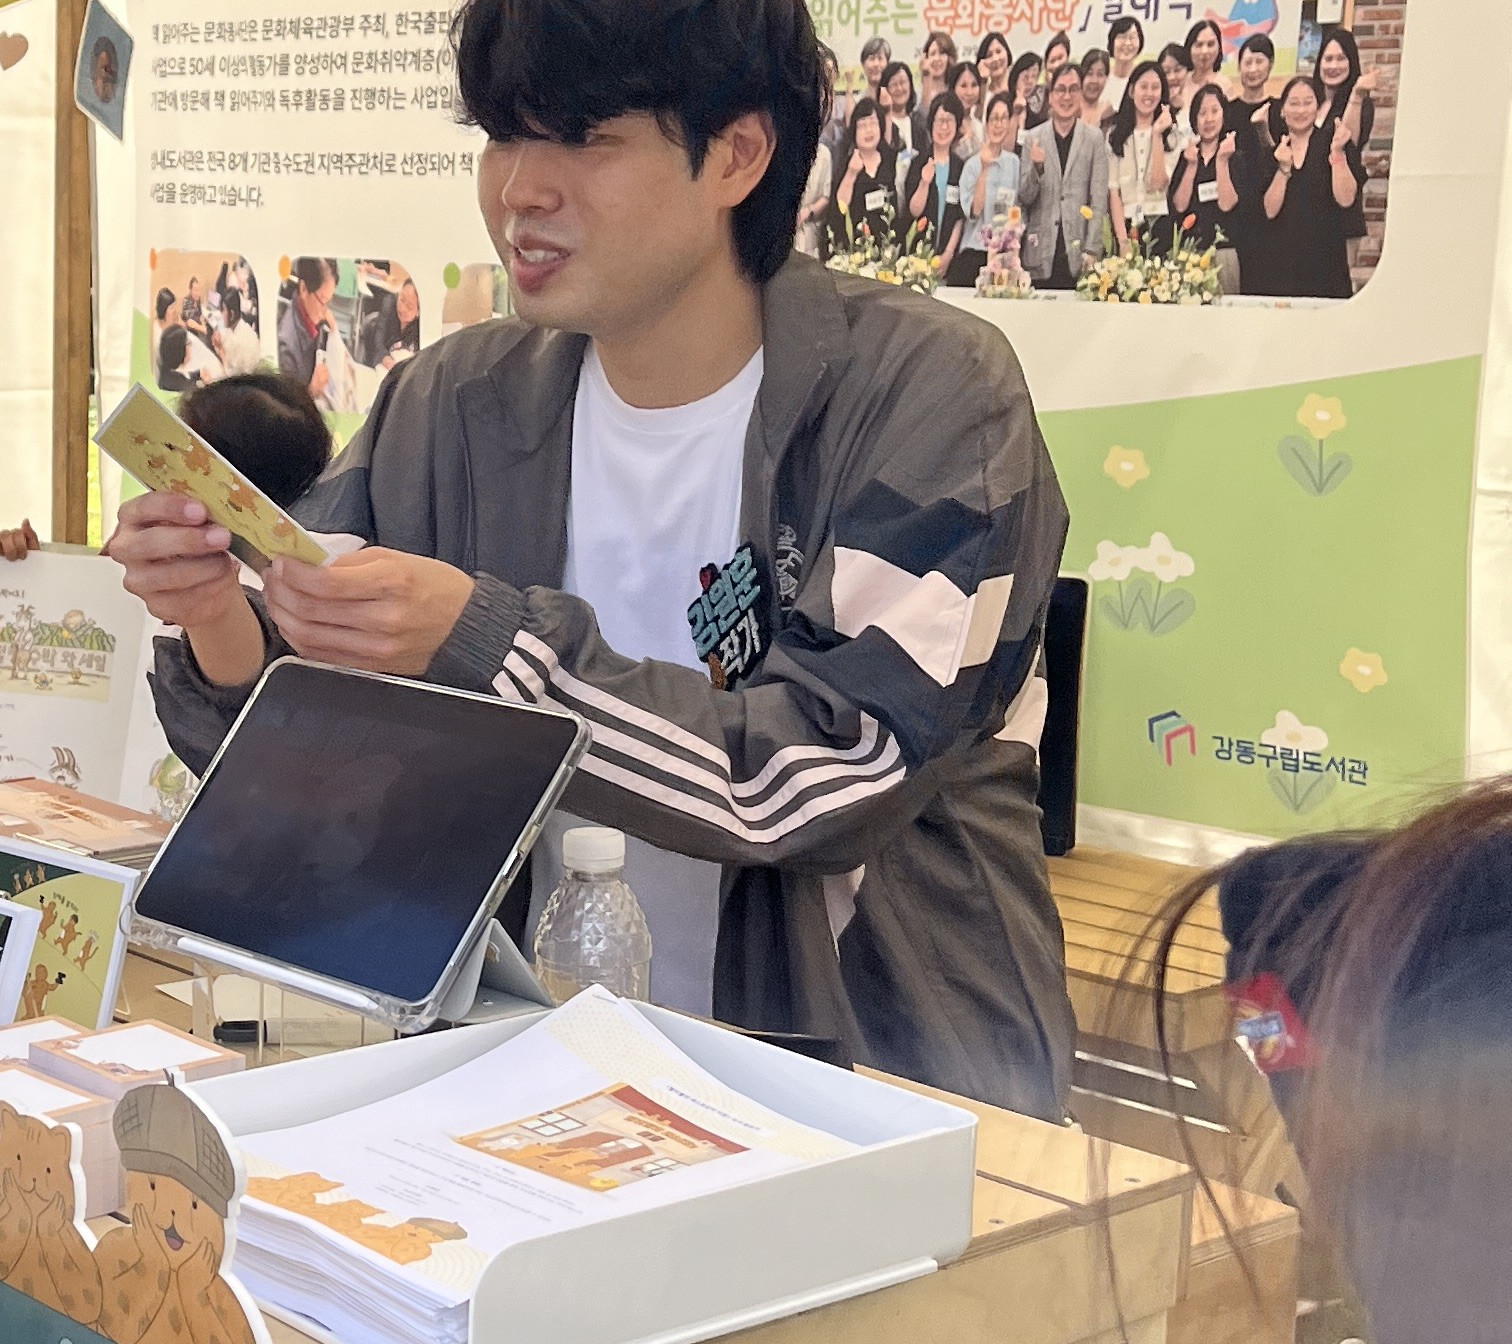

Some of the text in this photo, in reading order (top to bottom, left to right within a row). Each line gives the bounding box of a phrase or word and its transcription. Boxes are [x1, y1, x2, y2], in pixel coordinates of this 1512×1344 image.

[261, 14, 355, 41] 문화체육관광부
[358, 12, 390, 39] 주최,
[293, 50, 349, 76] 양성하여
[278, 86, 346, 112] 독후활동을
[348, 84, 408, 112] 진행하는
[227, 150, 249, 174] 8개
[317, 150, 397, 177] 지역주관처로
[399, 150, 456, 177] 선정되어
[458, 150, 474, 177] 책
[718, 606, 762, 678] 작가
[1211, 735, 1370, 787] 강동구립도서관
